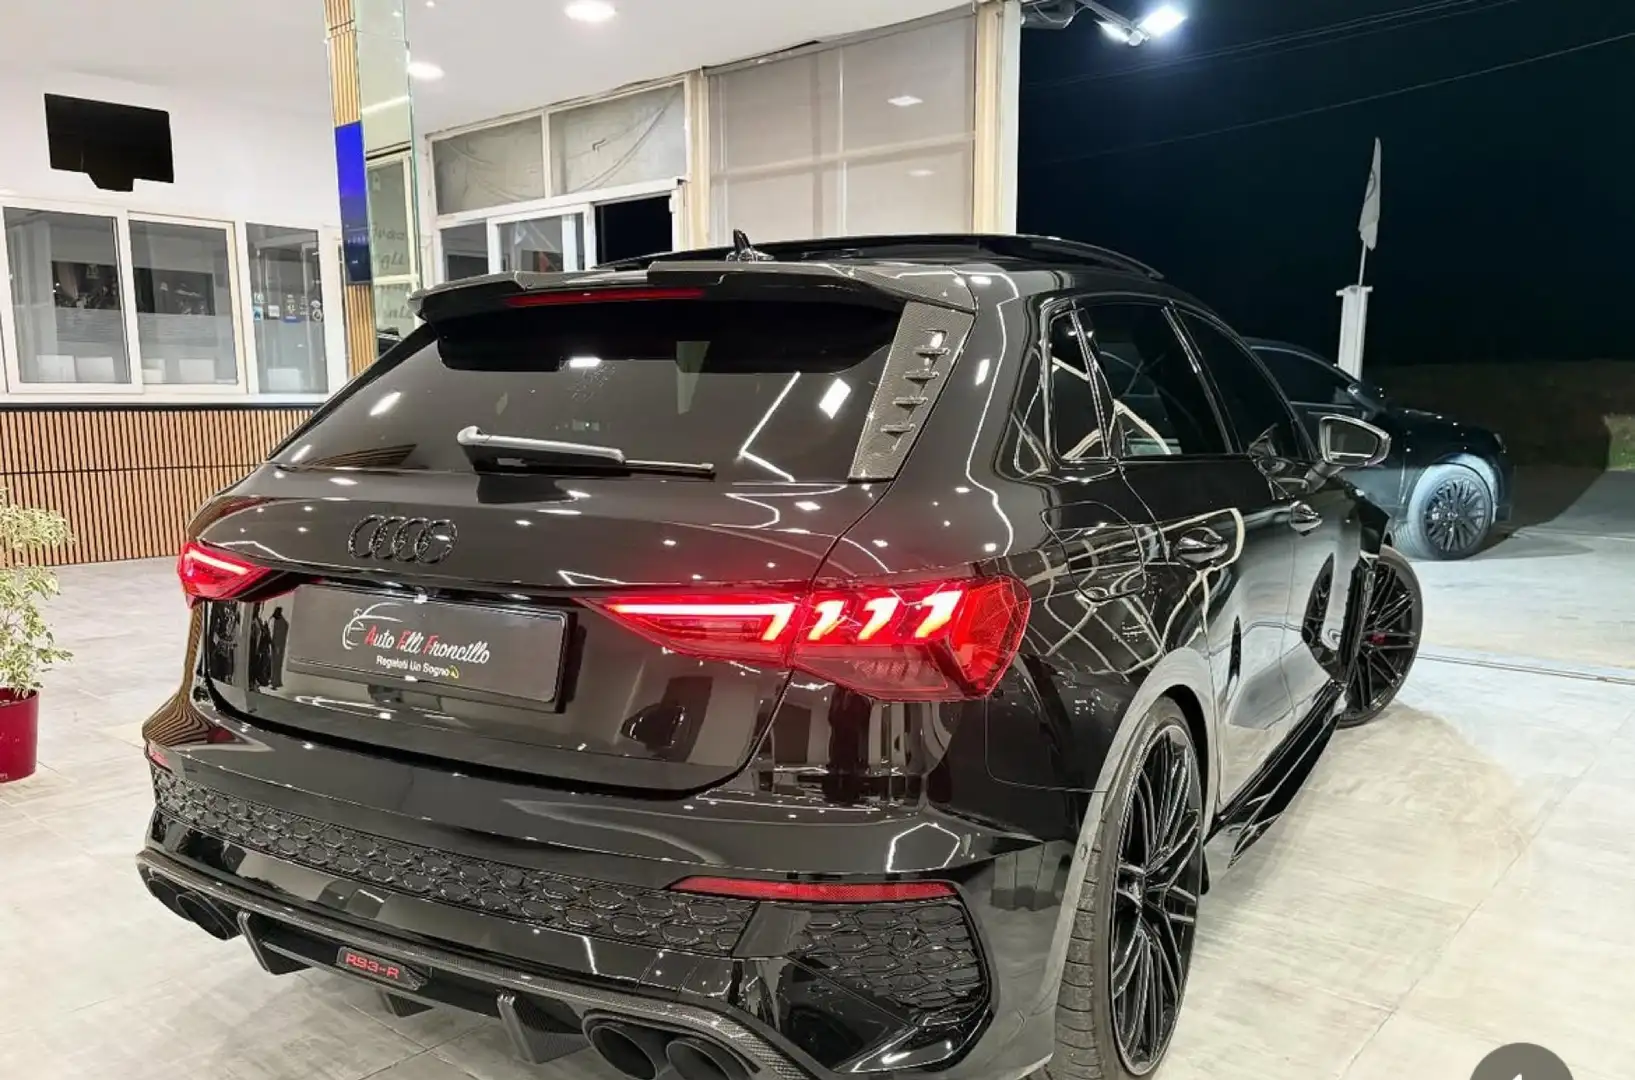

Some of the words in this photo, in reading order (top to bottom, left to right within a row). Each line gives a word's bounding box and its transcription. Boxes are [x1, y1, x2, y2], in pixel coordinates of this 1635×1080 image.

[364, 625, 395, 649] Auto
[409, 661, 421, 672] Un
[422, 662, 450, 677] Sogno
[345, 953, 400, 979] RS3-R
